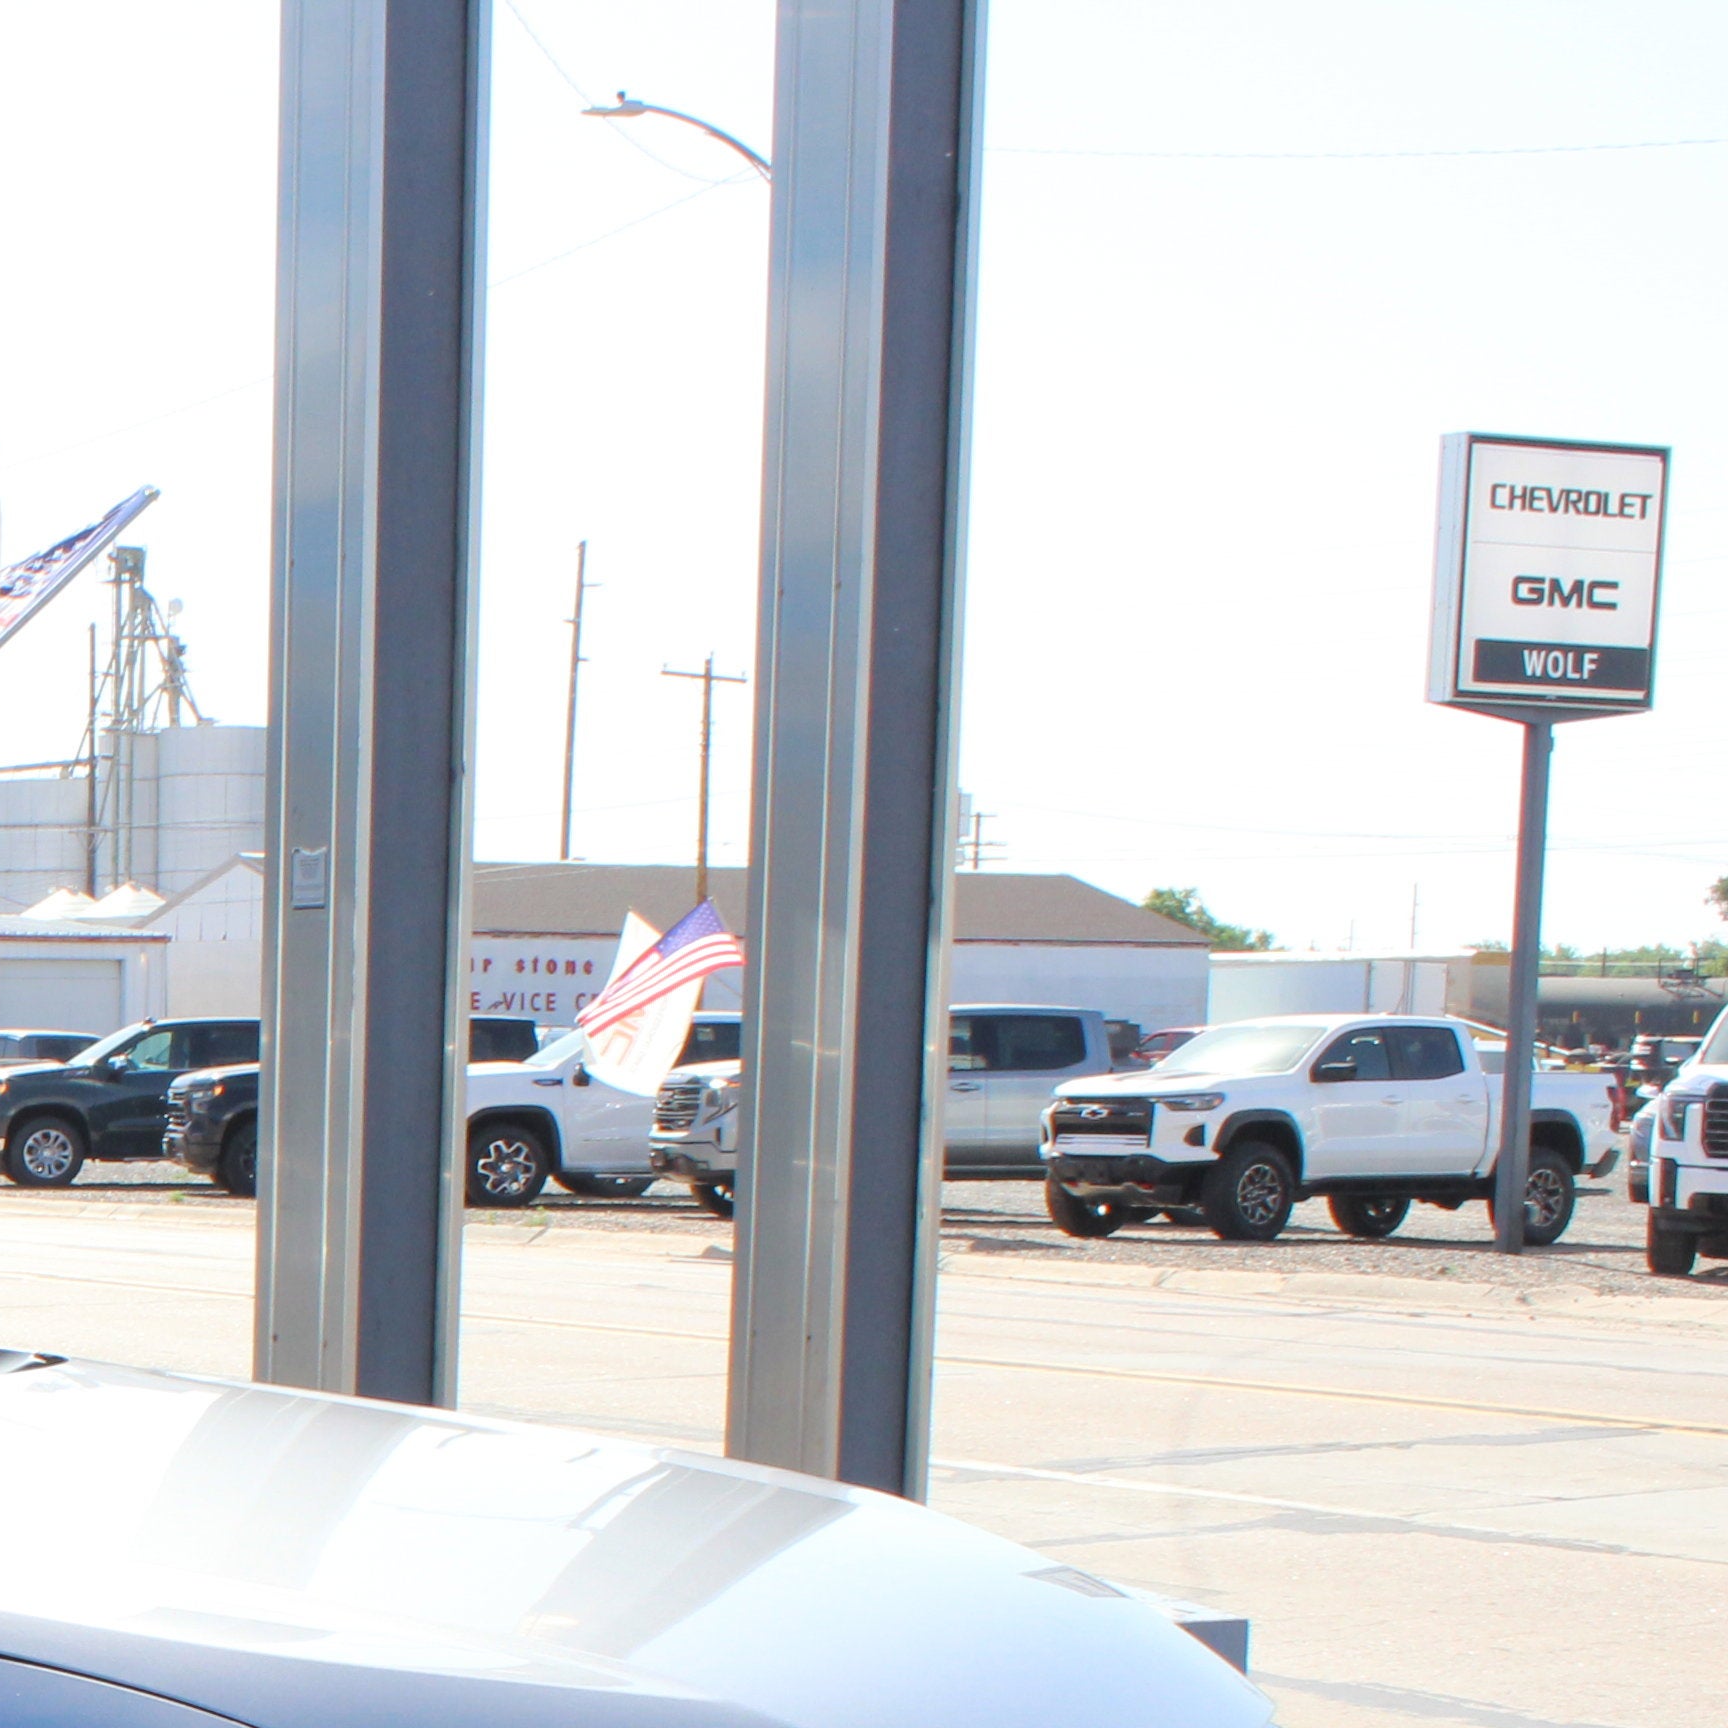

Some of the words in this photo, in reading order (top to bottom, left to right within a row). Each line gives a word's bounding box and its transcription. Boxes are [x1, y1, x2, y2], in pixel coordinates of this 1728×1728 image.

[1490, 482, 1654, 520] CHEVROLET
[1511, 574, 1620, 611] GMC
[1522, 649, 1600, 681] WOLF
